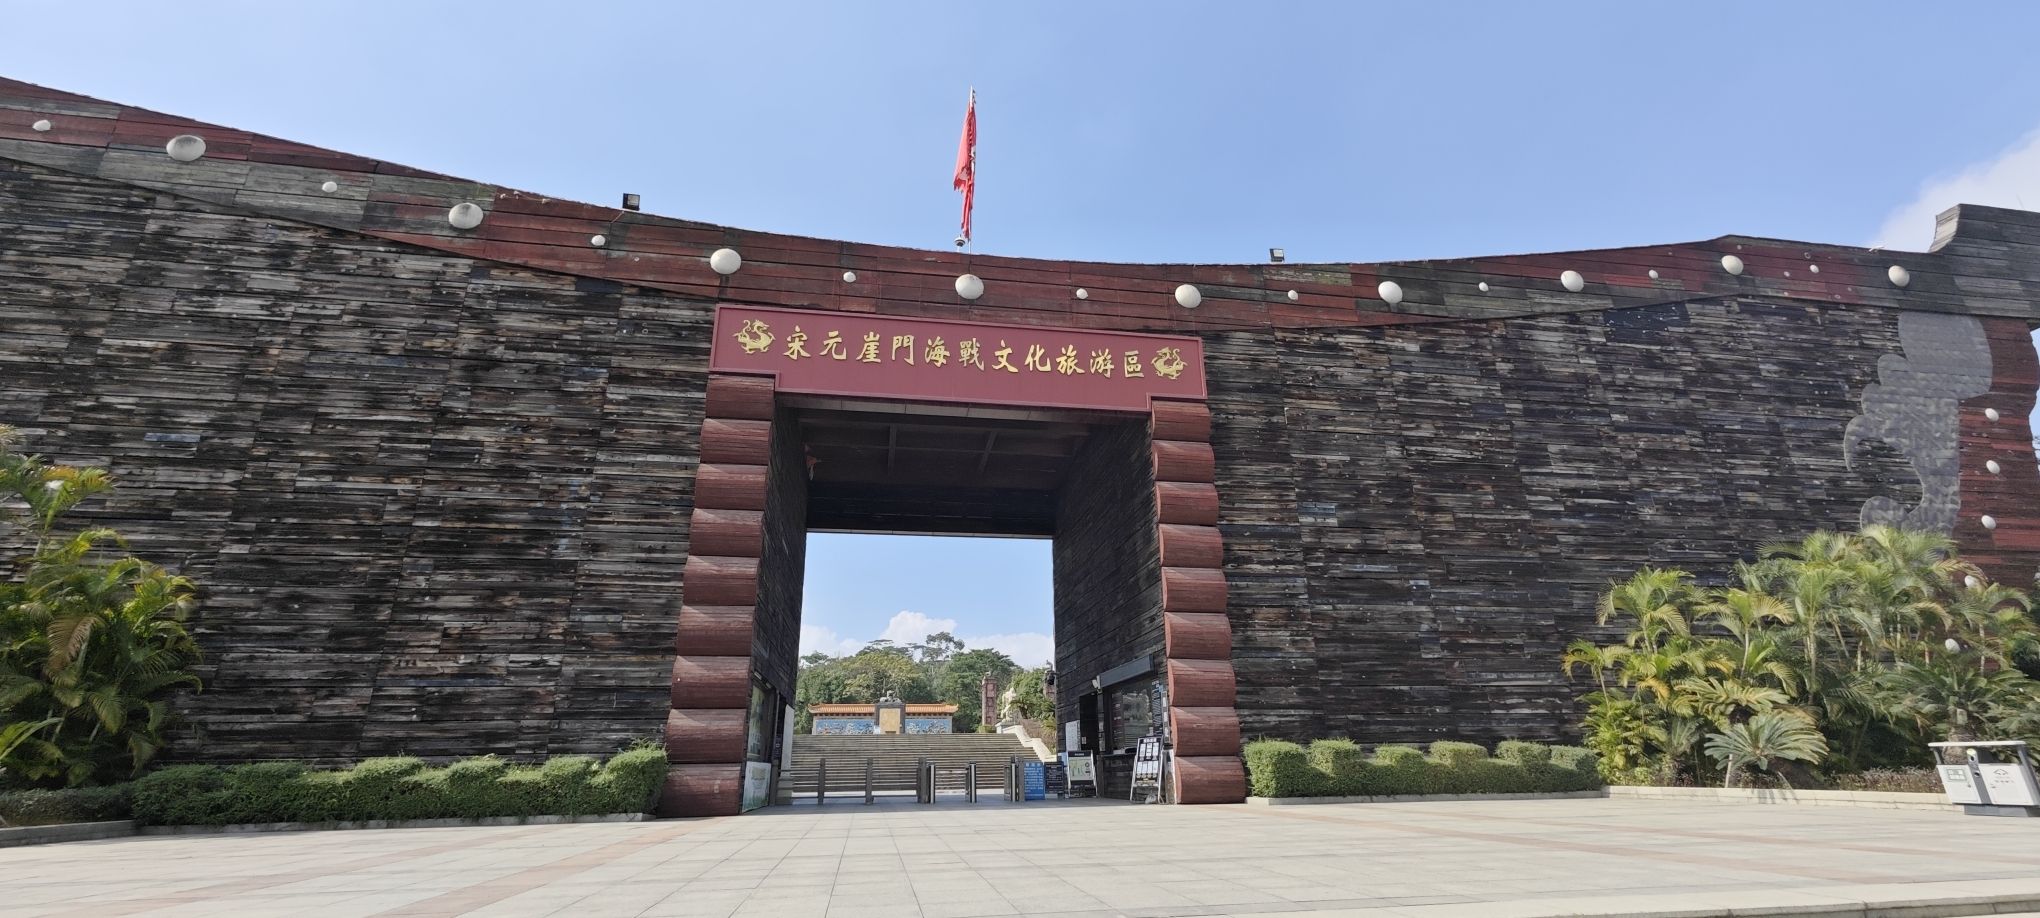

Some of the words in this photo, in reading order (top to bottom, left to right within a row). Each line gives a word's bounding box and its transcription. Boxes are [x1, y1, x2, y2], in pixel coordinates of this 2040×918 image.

[783, 325, 1145, 379] 宋元崖門海戰文化旅游區
